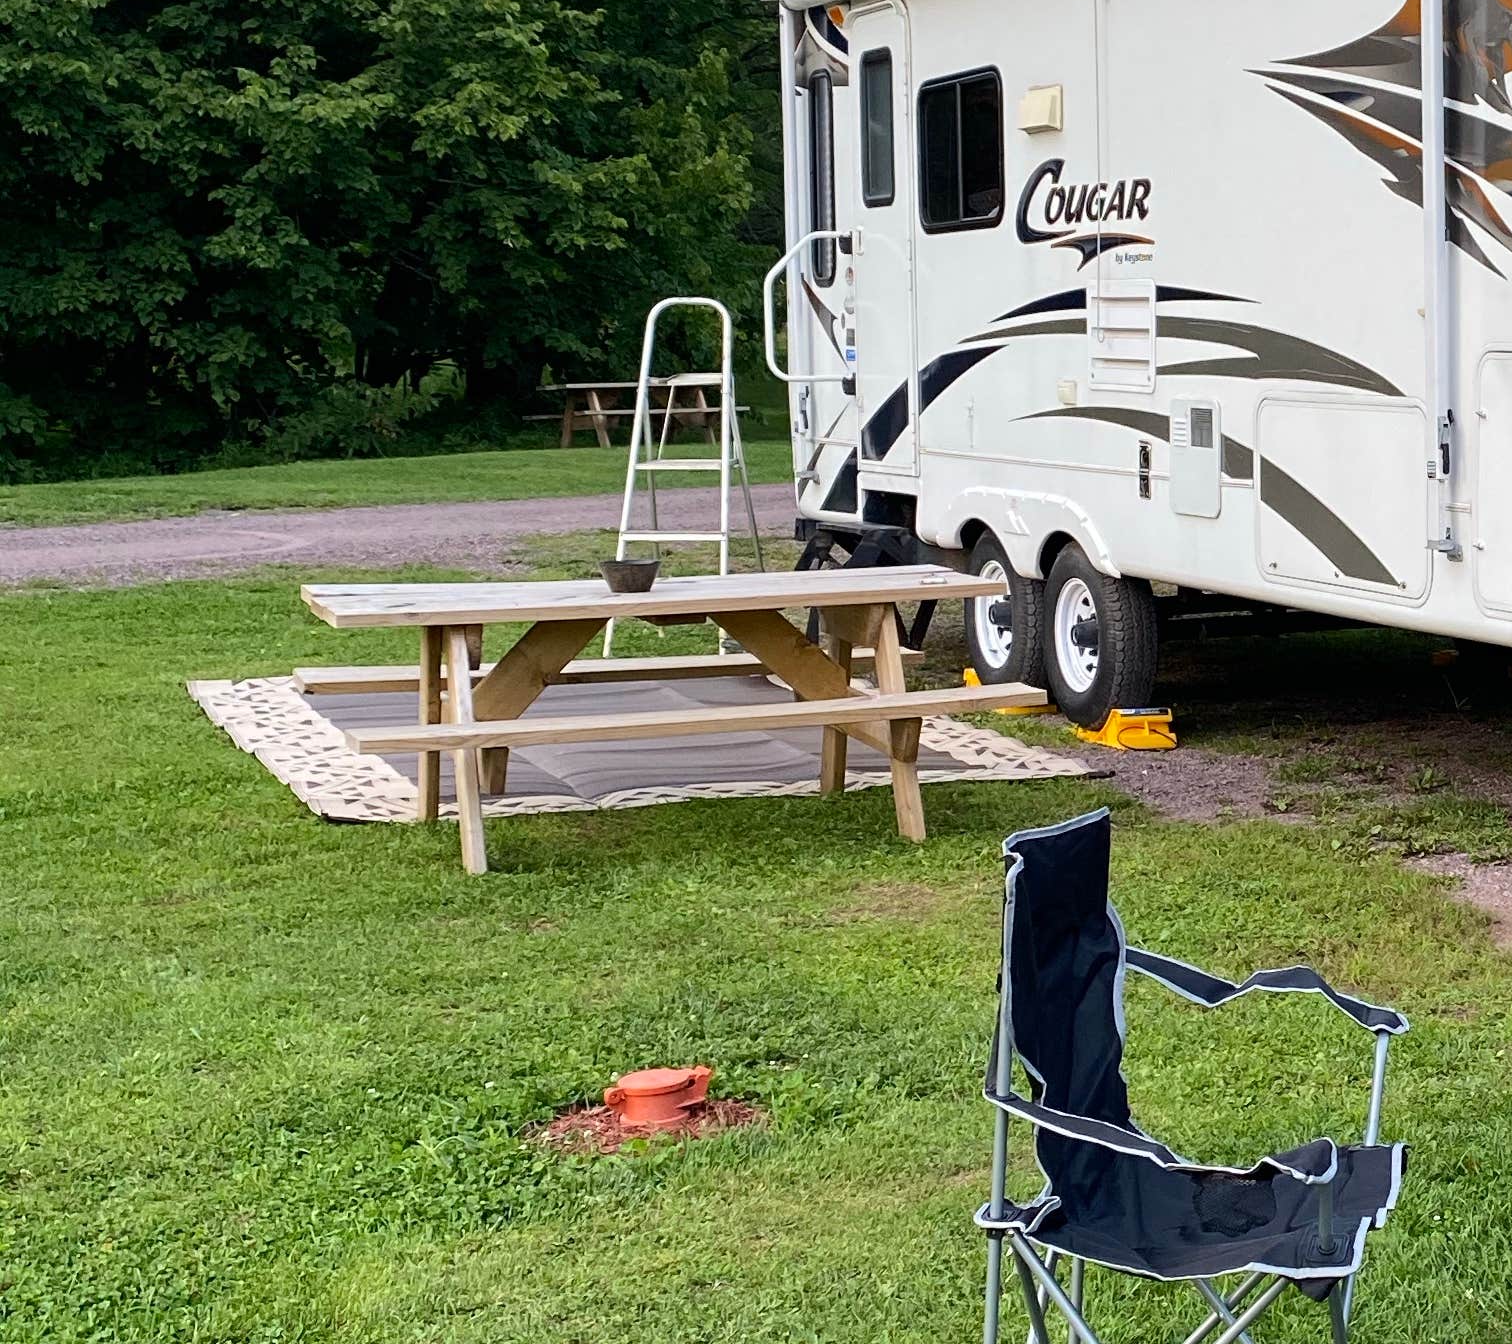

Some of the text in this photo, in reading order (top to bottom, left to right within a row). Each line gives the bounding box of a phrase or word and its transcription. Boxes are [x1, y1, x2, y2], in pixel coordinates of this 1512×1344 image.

[1015, 157, 1152, 244] COUGAR
[1115, 252, 1153, 265] by Keystone
